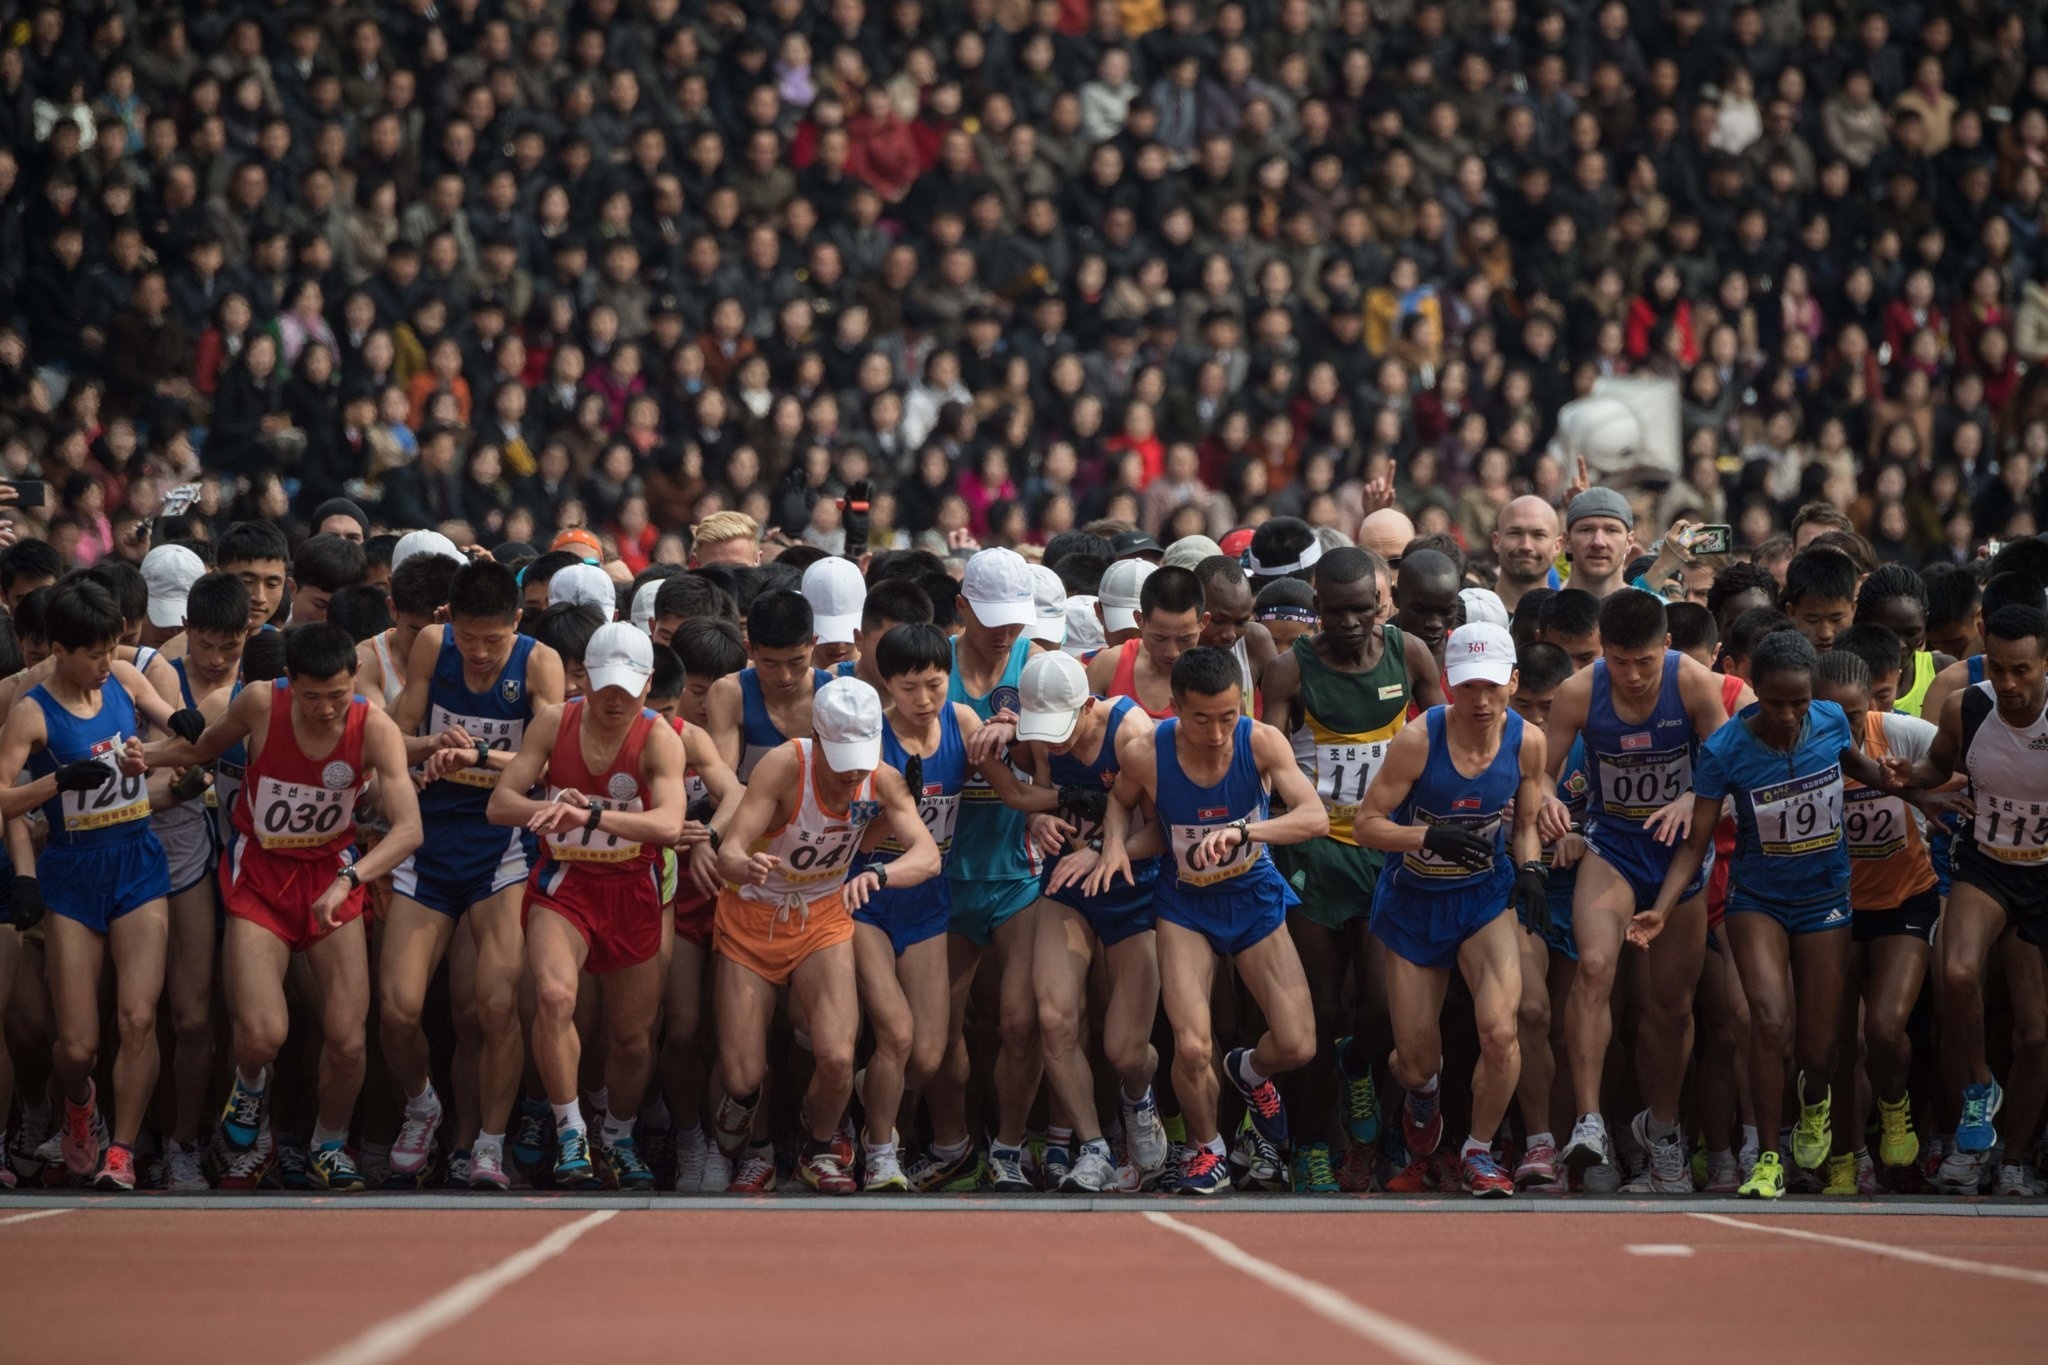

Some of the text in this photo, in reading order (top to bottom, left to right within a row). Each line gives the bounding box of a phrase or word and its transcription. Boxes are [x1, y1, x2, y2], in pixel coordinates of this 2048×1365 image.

[1330, 744, 1390, 761] 조선-평
[271, 783, 343, 802] 조선-평양
[1613, 768, 1682, 802] 005
[264, 800, 343, 833] 030
[1778, 796, 1836, 840] 191
[1847, 809, 1892, 842] 92
[1987, 811, 2048, 847] 115
